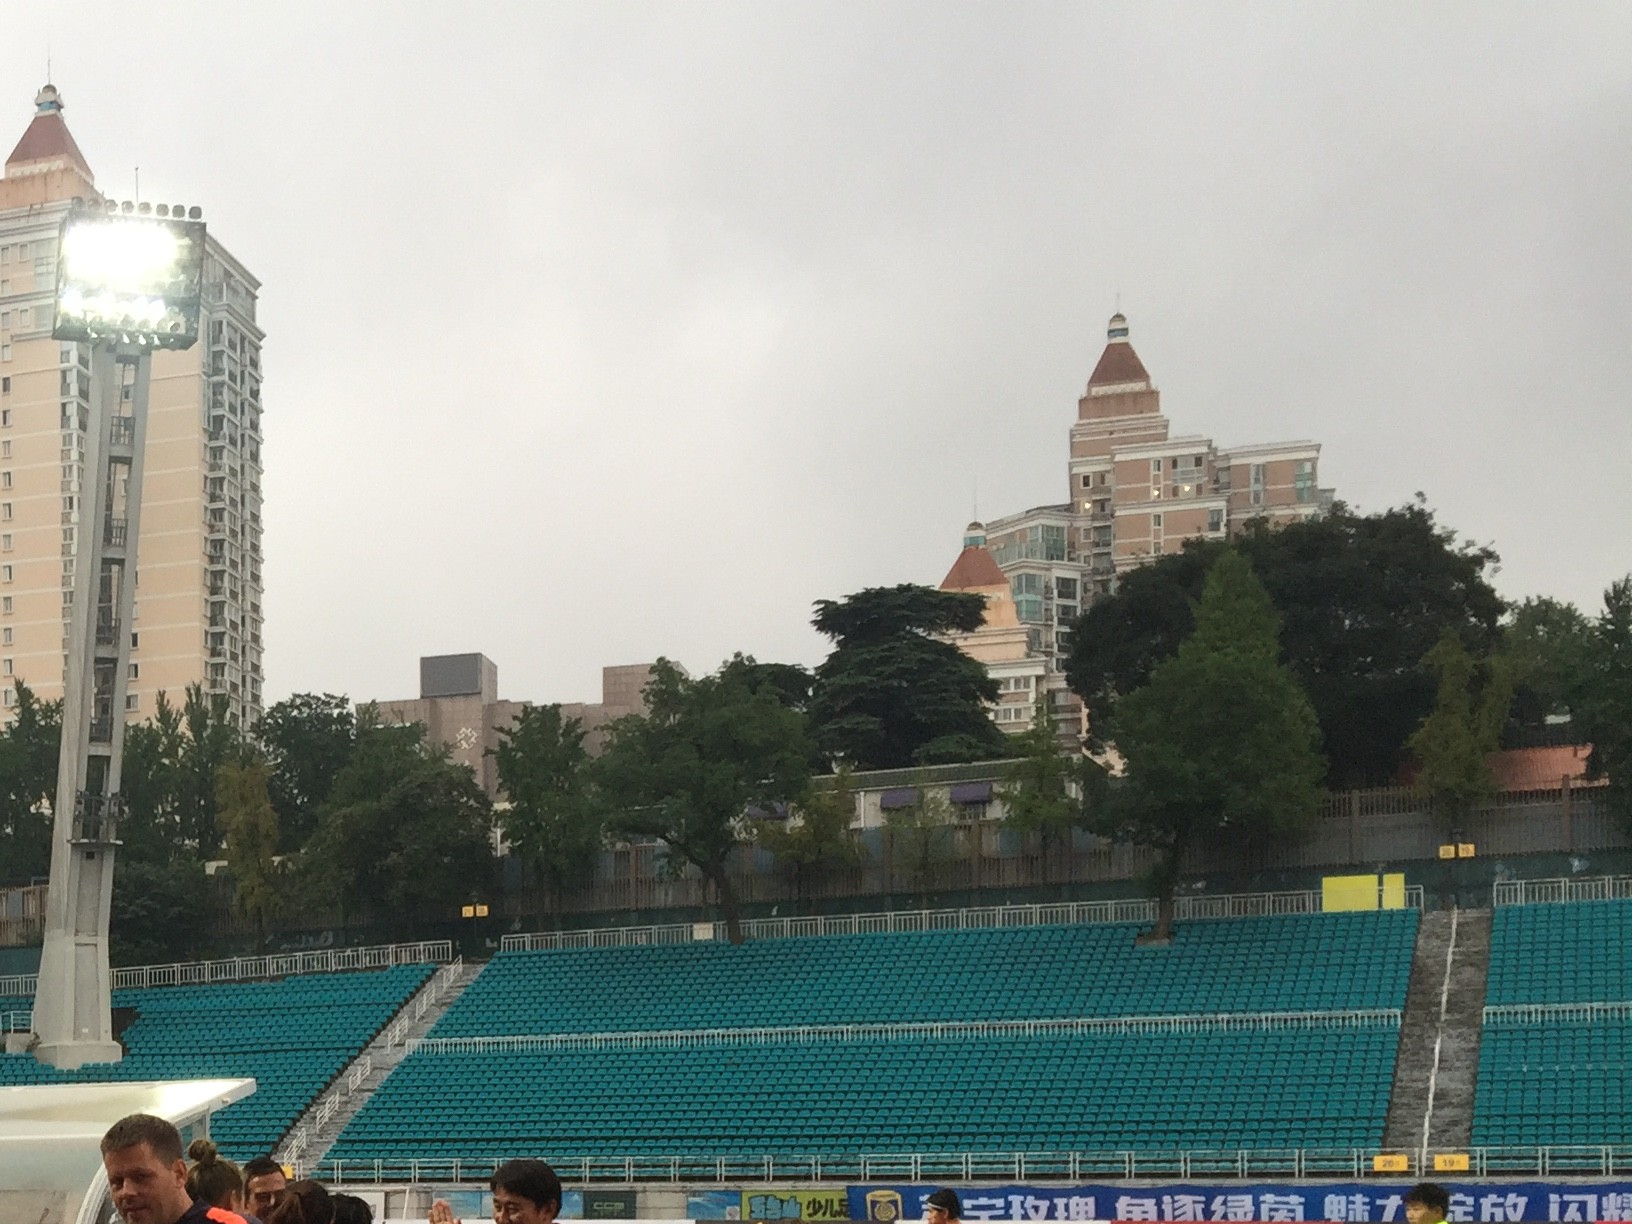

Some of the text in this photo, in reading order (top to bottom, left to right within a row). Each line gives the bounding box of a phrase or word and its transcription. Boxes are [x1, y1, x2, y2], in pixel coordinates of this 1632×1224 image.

[919, 1194, 1095, 1221] 宁玫瑰
[1115, 1193, 1306, 1222] 角逐绿茵
